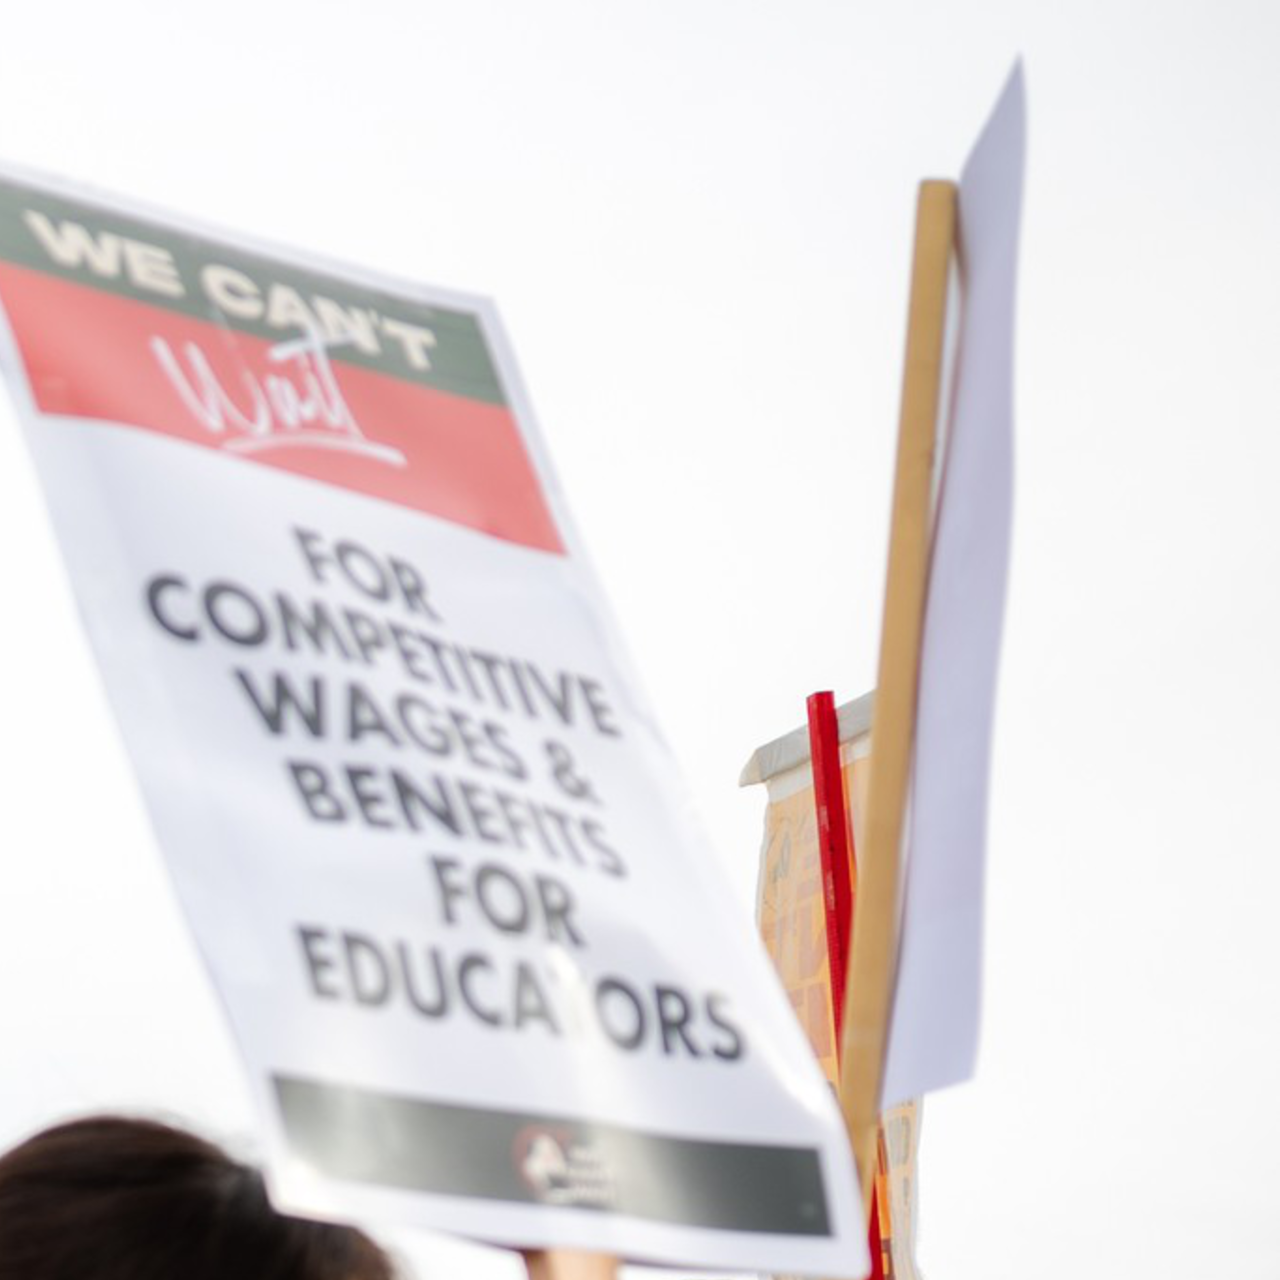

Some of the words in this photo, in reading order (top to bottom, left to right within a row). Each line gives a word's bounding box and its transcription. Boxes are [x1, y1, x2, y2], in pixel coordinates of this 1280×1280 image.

[23, 208, 186, 298] WE
[200, 264, 437, 372] CAN'T
[149, 318, 372, 450] Wait
[291, 522, 443, 624] FOR
[144, 570, 623, 740] COMPETITIVE
[234, 664, 531, 784] WAGES
[544, 738, 604, 806] &
[287, 758, 629, 882] BENEFITS
[429, 853, 587, 951] FOR
[296, 923, 745, 1063] EDUCAORS
